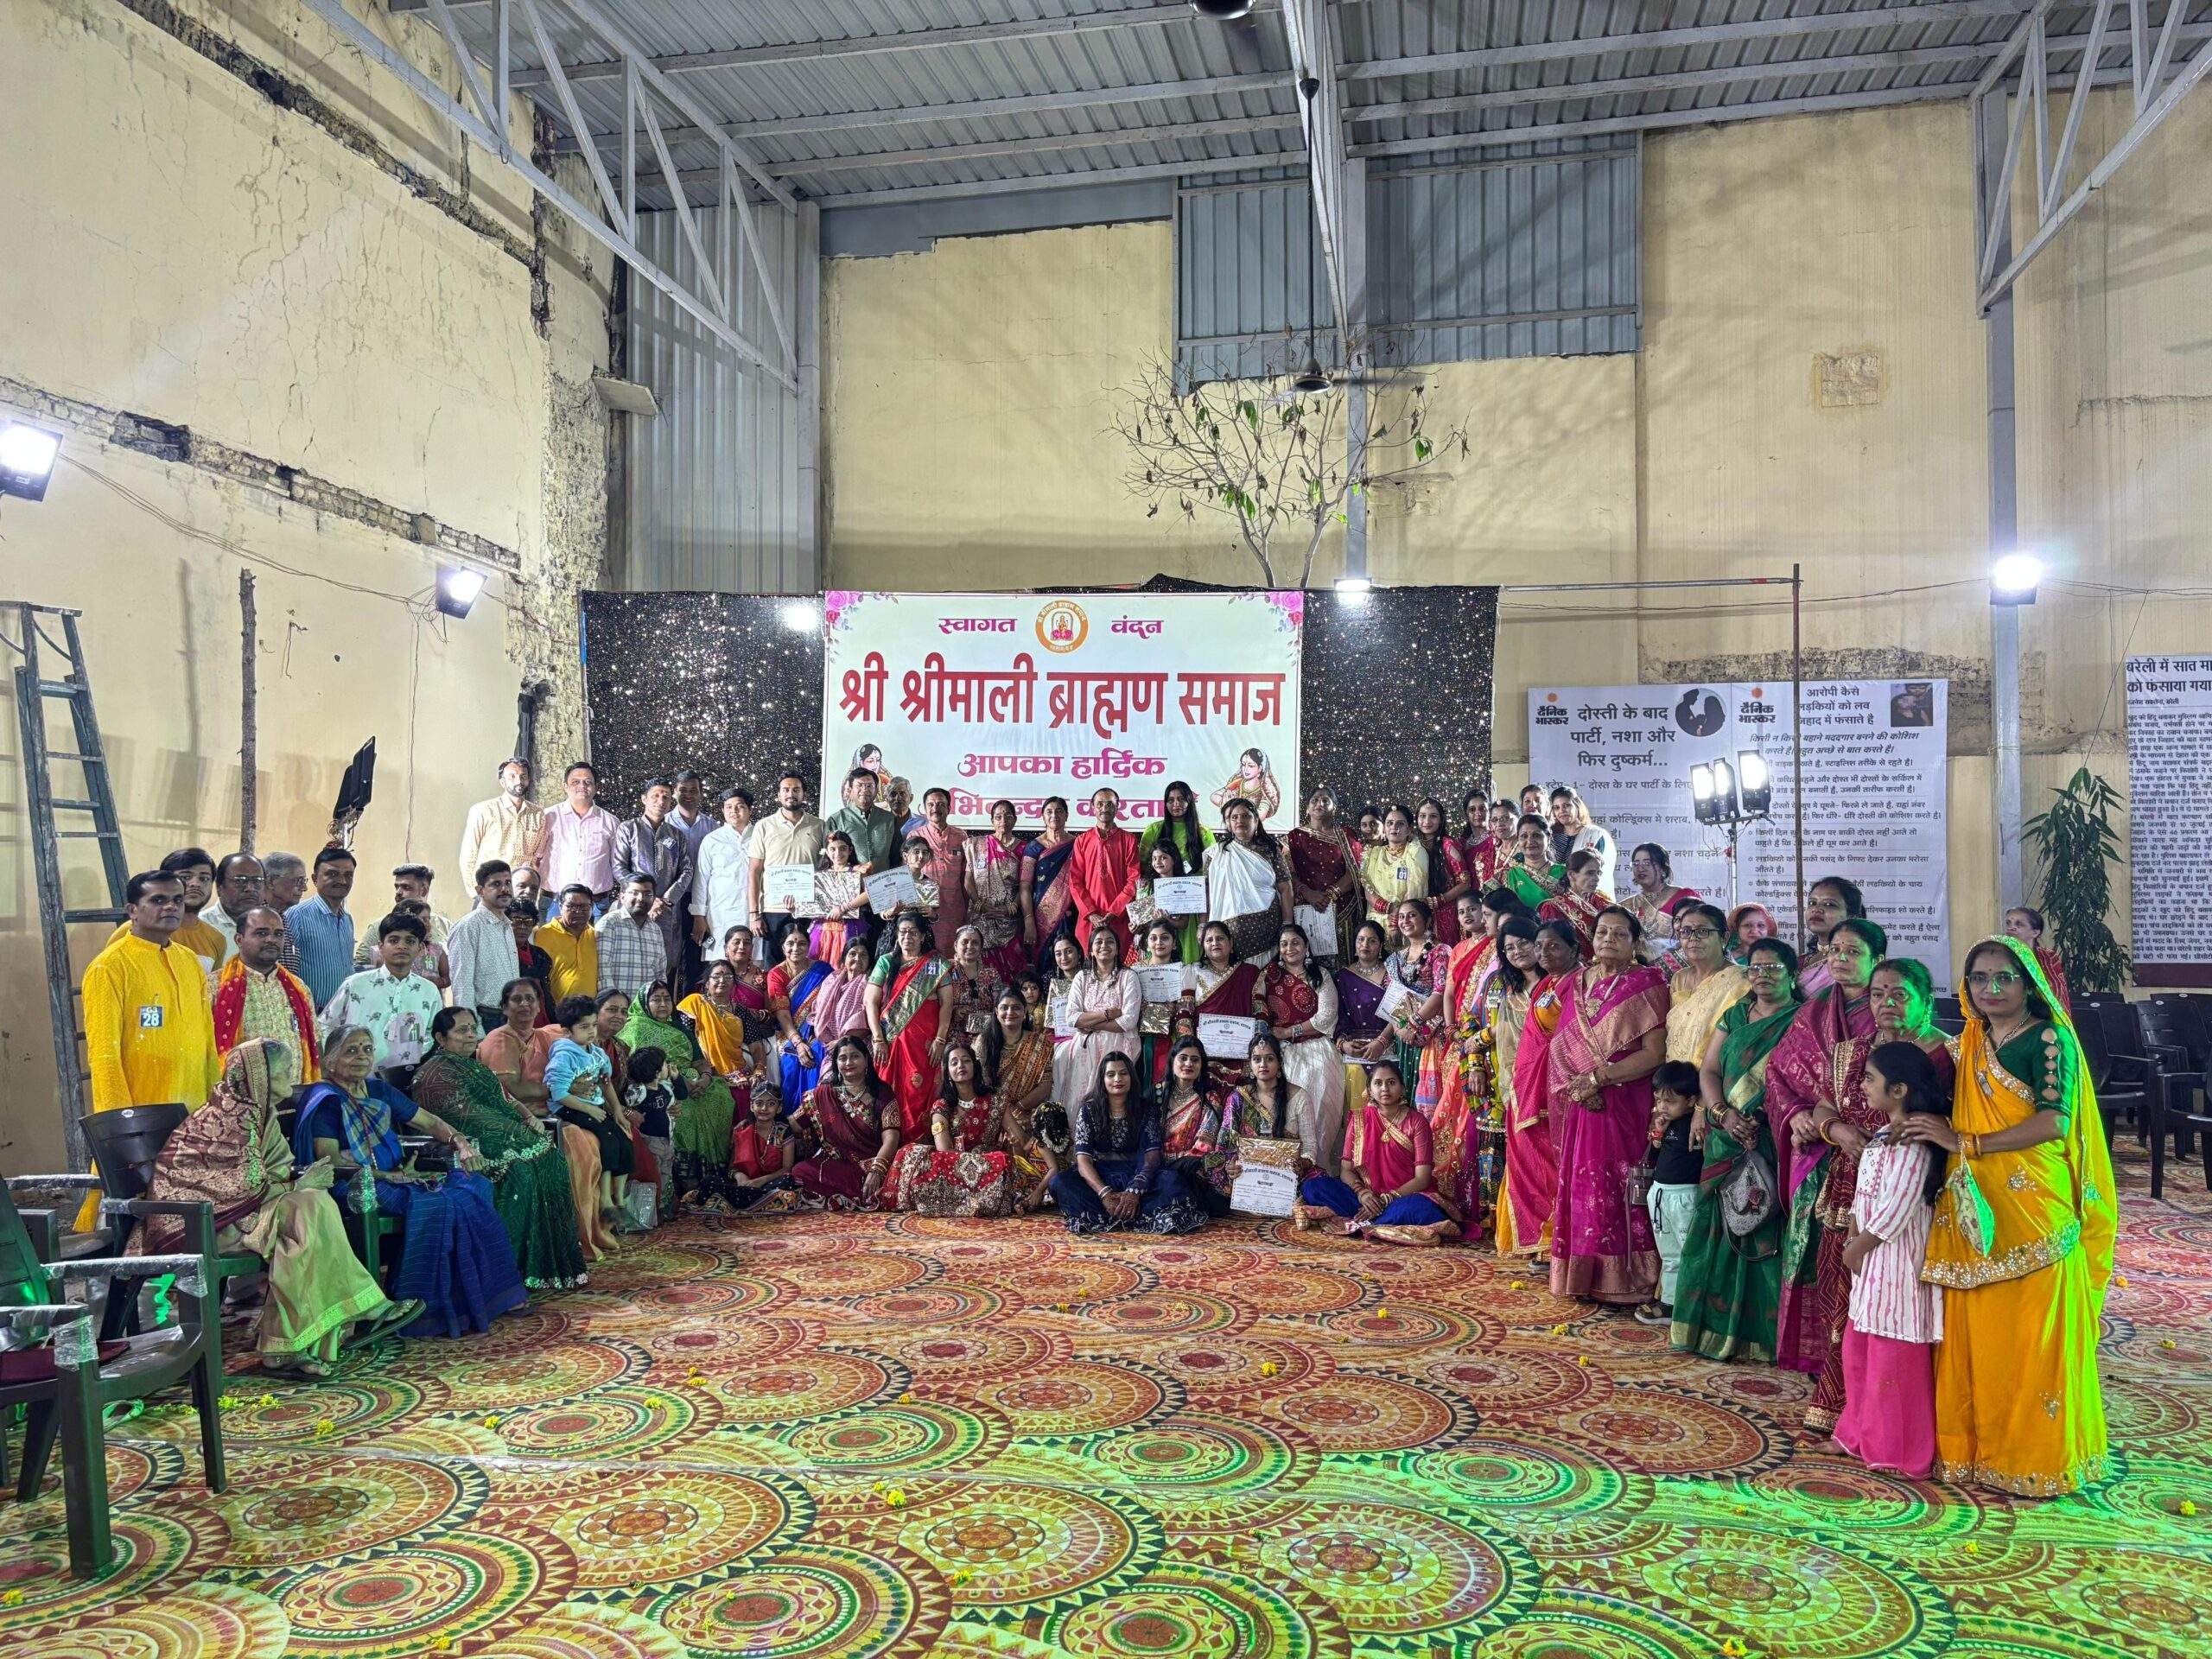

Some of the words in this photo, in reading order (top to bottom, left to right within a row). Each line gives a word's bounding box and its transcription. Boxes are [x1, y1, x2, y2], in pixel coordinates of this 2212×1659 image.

[938, 618, 1017, 634] स्वागत
[1111, 614, 1163, 639] वंदन
[2126, 658, 2156, 672] बरेली
[2158, 658, 2169, 672] में
[2172, 661, 2197, 672] सात
[1807, 686, 1838, 697] आरोपी
[1840, 686, 1859, 696] कैसे
[2126, 678, 2143, 692] को
[2145, 678, 2187, 693] फंसाया
[839, 652, 888, 722] श्री
[899, 652, 1038, 723] श्रीमाली
[1046, 672, 1168, 740] ब्राह्मण
[1178, 673, 1286, 726] समाज
[1537, 705, 1567, 716] दैनिक
[1577, 703, 1618, 721] दोस्ती
[1623, 703, 1638, 720] के
[1643, 707, 1669, 720] बाद
[1740, 702, 1774, 714] दैनिक
[1838, 700, 1852, 710] को
[1854, 702, 1870, 710] लव
[1535, 716, 1568, 725] भास्कर
[1738, 715, 1776, 723] भास्कर
[1570, 727, 1605, 745] पार्टी,
[1611, 731, 1642, 742] नशा
[1647, 727, 1675, 742] और
[957, 754, 1064, 778] आपका
[1072, 747, 1167, 779] हार्दिक
[1578, 751, 1606, 766] फिर
[1588, 779, 1610, 790] दोस्त
[1613, 779, 1622, 788] के
[1662, 779, 1671, 789] के
[928, 966, 937, 975] 21
[142, 1013, 160, 1027] 28
